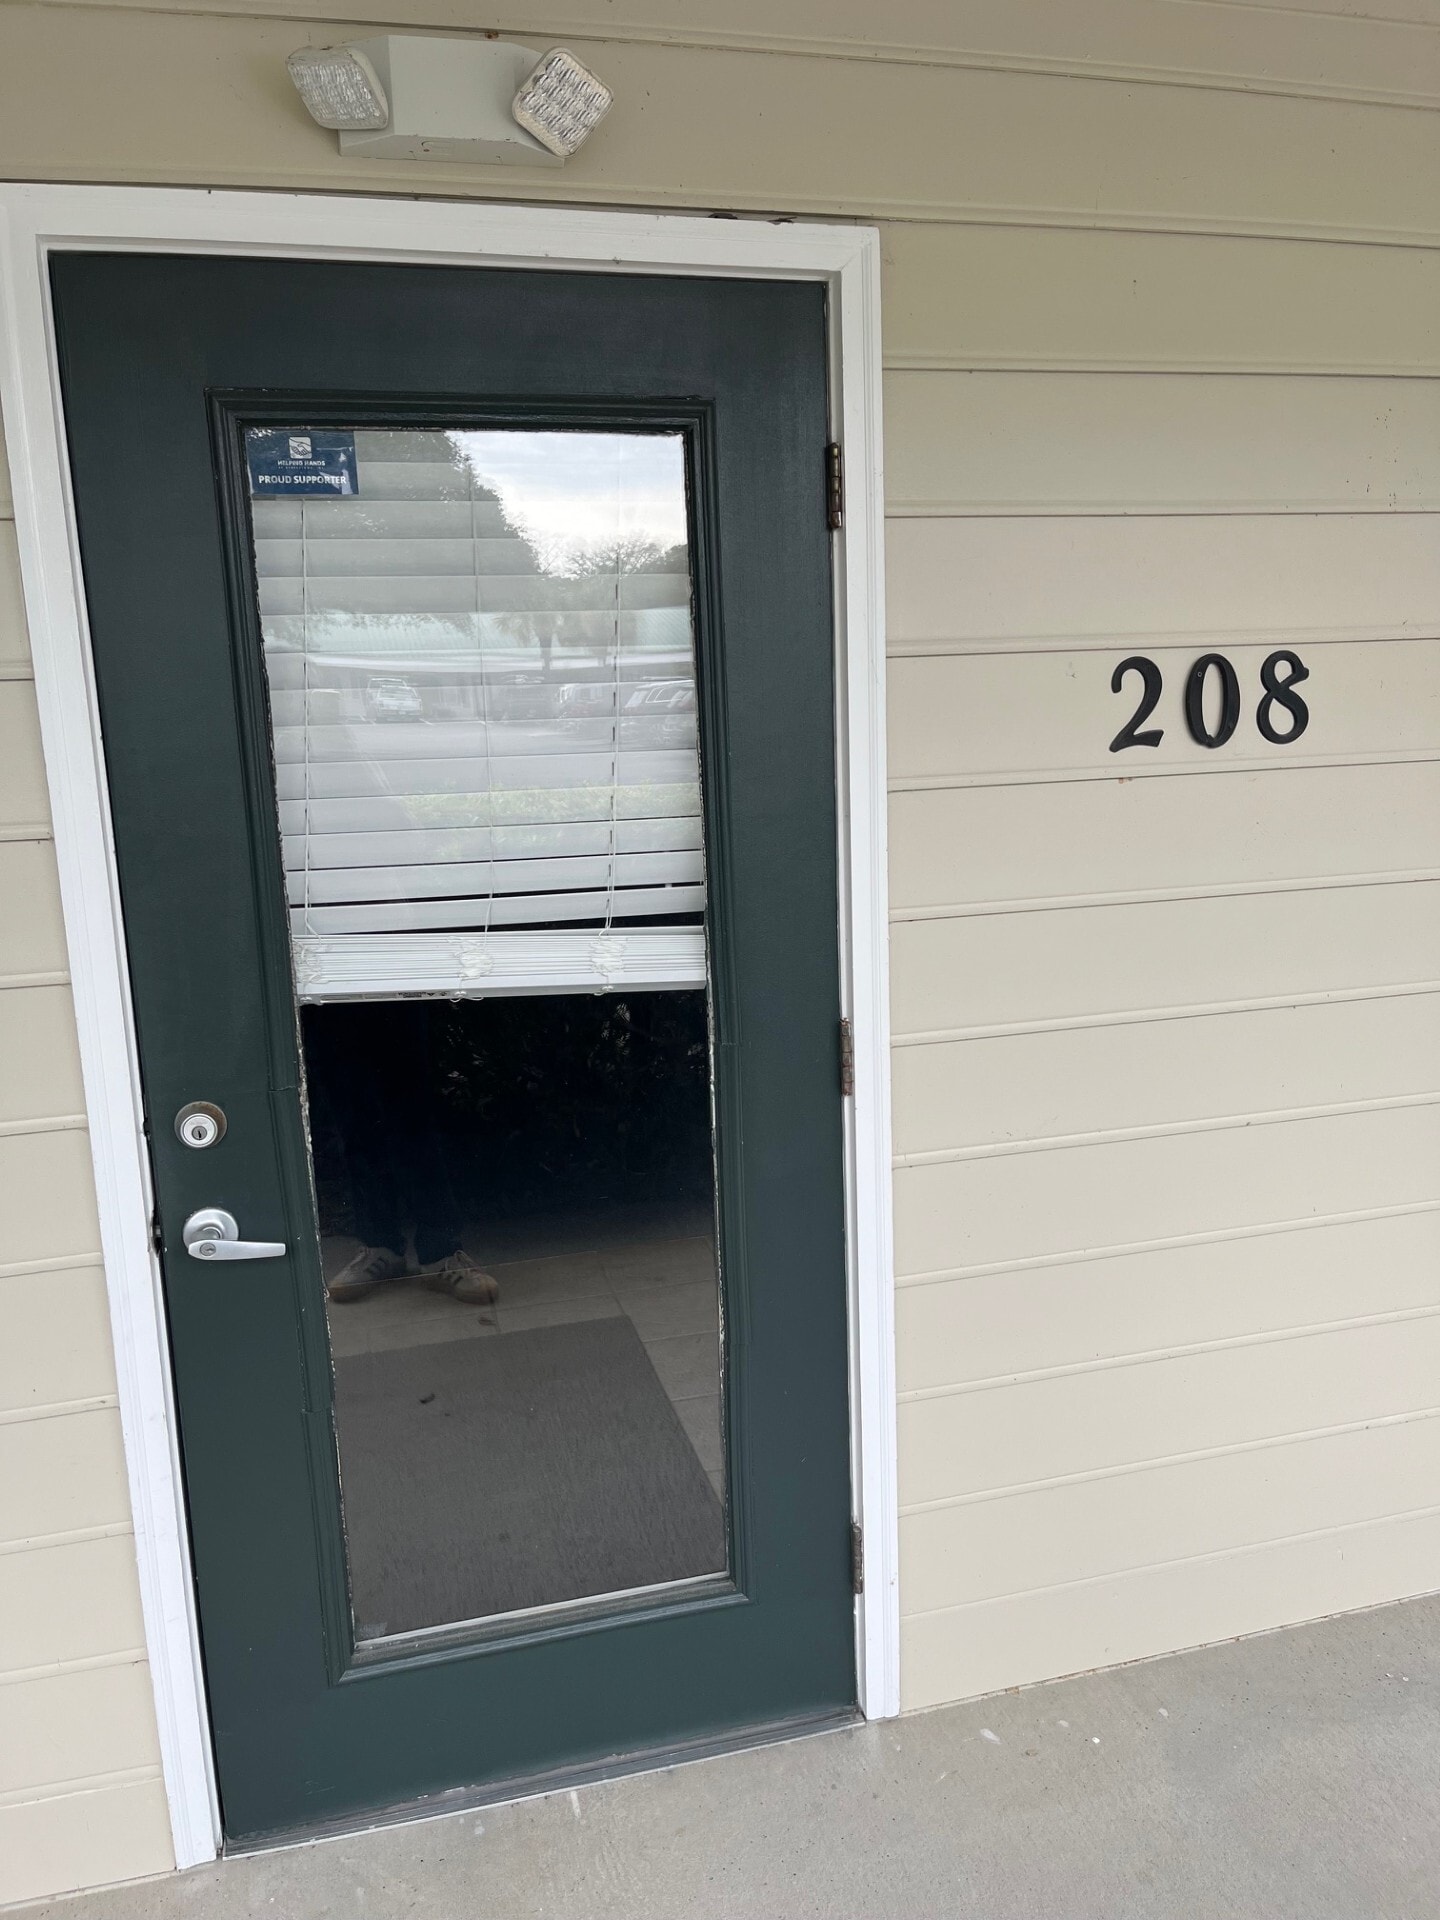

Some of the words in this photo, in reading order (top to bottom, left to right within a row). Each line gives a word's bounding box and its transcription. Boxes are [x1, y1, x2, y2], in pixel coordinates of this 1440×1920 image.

[259, 475, 291, 484] PROUD
[293, 475, 346, 484] SUPPORTER
[1109, 650, 1310, 753] 208
